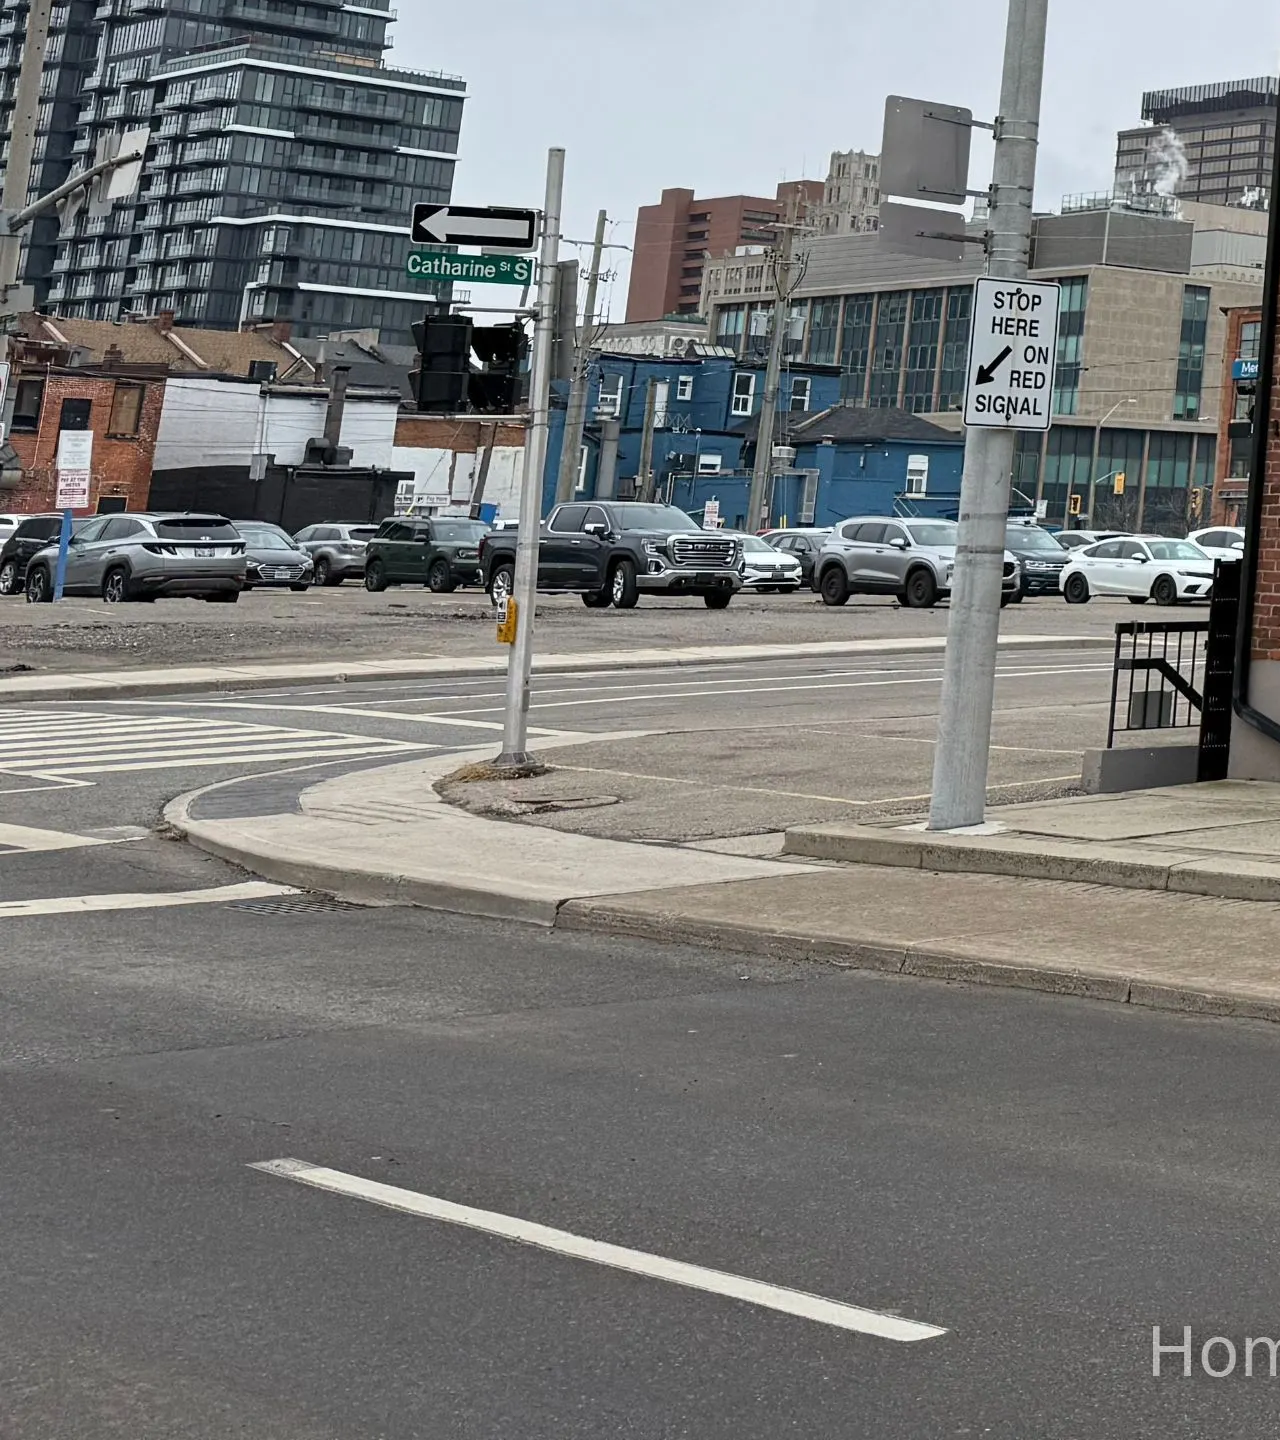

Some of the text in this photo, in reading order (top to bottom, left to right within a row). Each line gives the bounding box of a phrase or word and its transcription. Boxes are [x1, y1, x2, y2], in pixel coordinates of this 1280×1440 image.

[407, 254, 529, 281] Catharine St S
[993, 290, 1042, 312] STOP
[991, 316, 1040, 338] HERE
[1023, 345, 1049, 365] ON
[1009, 370, 1046, 390] RED
[974, 394, 1043, 416] SIGNAL
